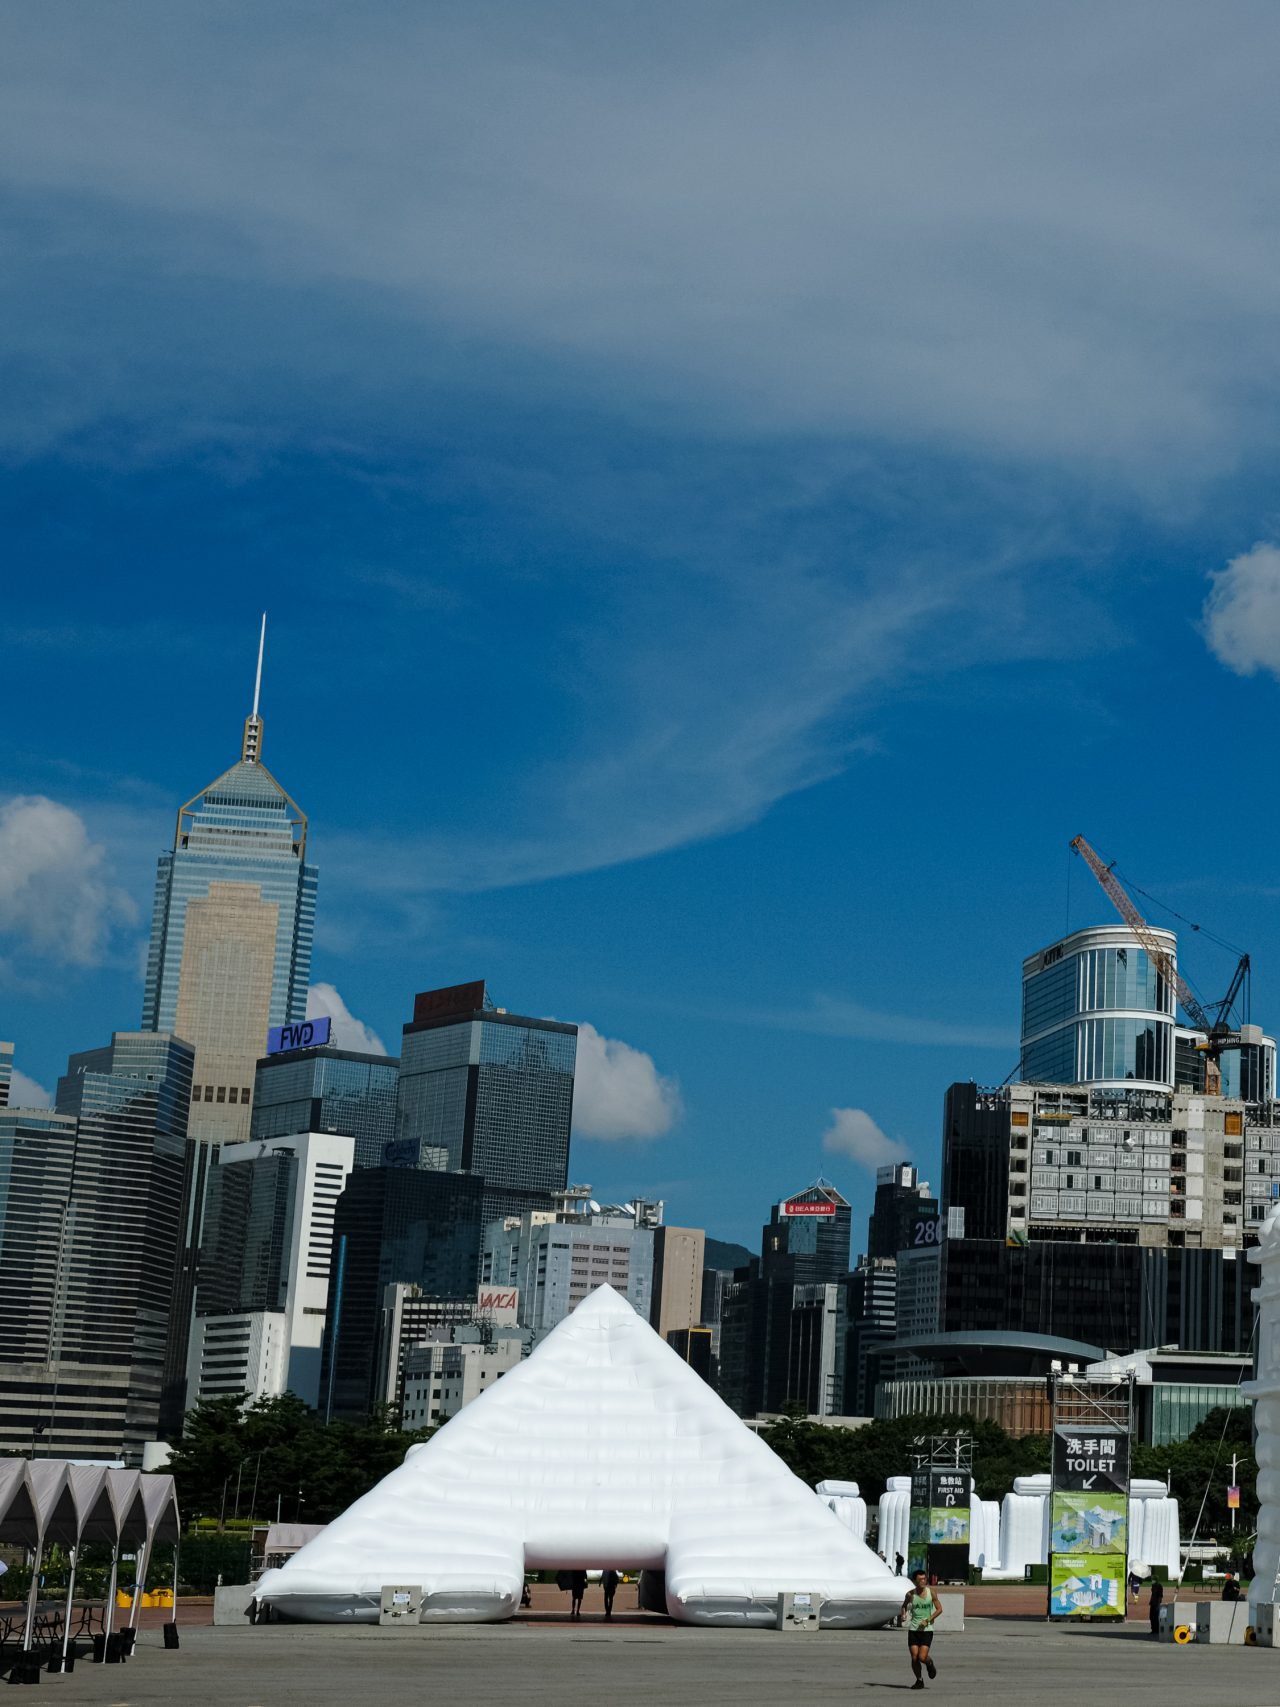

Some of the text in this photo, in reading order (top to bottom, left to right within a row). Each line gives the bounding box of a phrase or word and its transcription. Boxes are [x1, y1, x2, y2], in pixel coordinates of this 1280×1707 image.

[280, 1023, 313, 1050] FWD
[1066, 1438, 1116, 1456] 洗手間
[1066, 1458, 1116, 1473] TOILET
